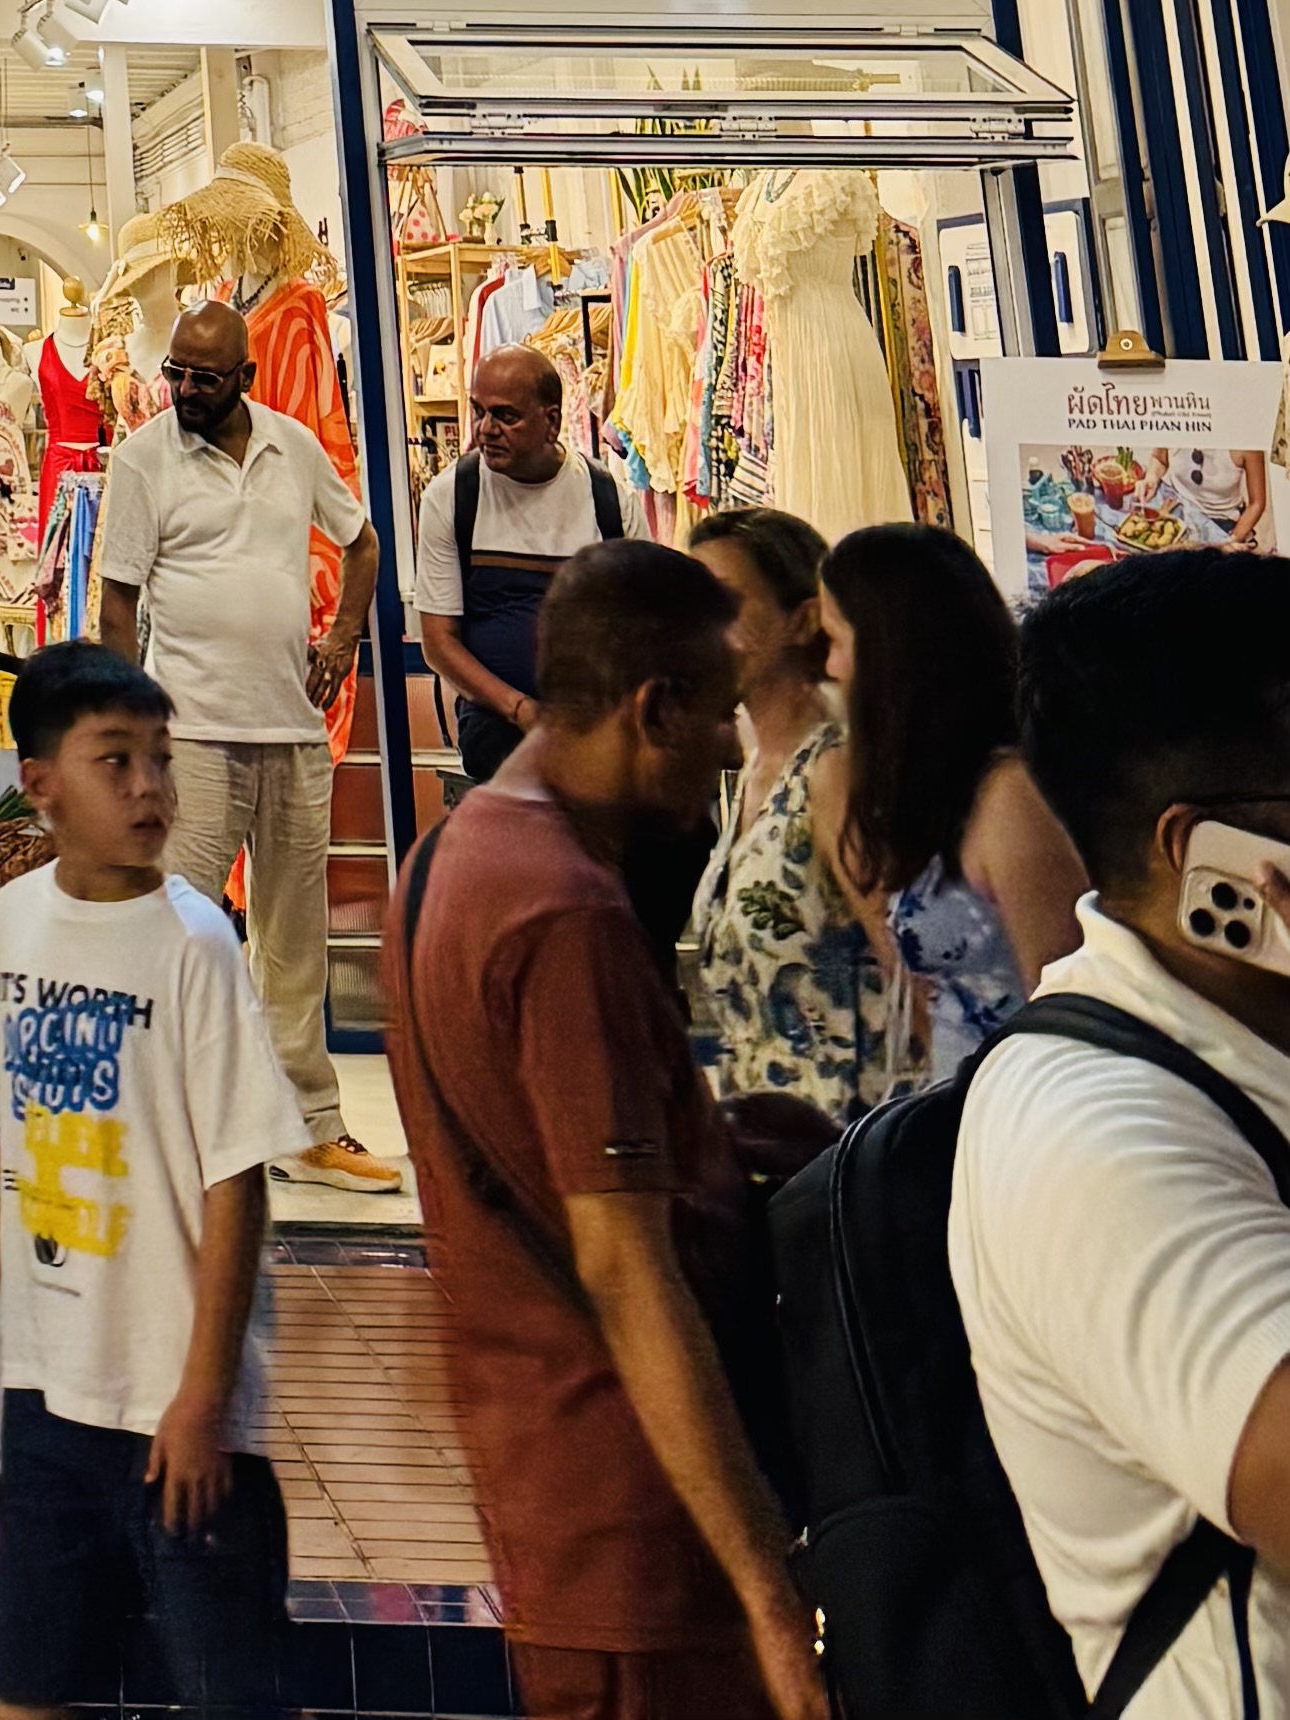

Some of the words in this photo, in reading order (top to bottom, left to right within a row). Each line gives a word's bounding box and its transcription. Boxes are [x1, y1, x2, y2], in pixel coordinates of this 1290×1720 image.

[1067, 382, 1148, 416] ผัดไทย
[1067, 418, 1097, 429] PAD
[1101, 419, 1136, 430] THAI
[1140, 420, 1181, 431] PHAN
[1185, 421, 1212, 432] HIN
